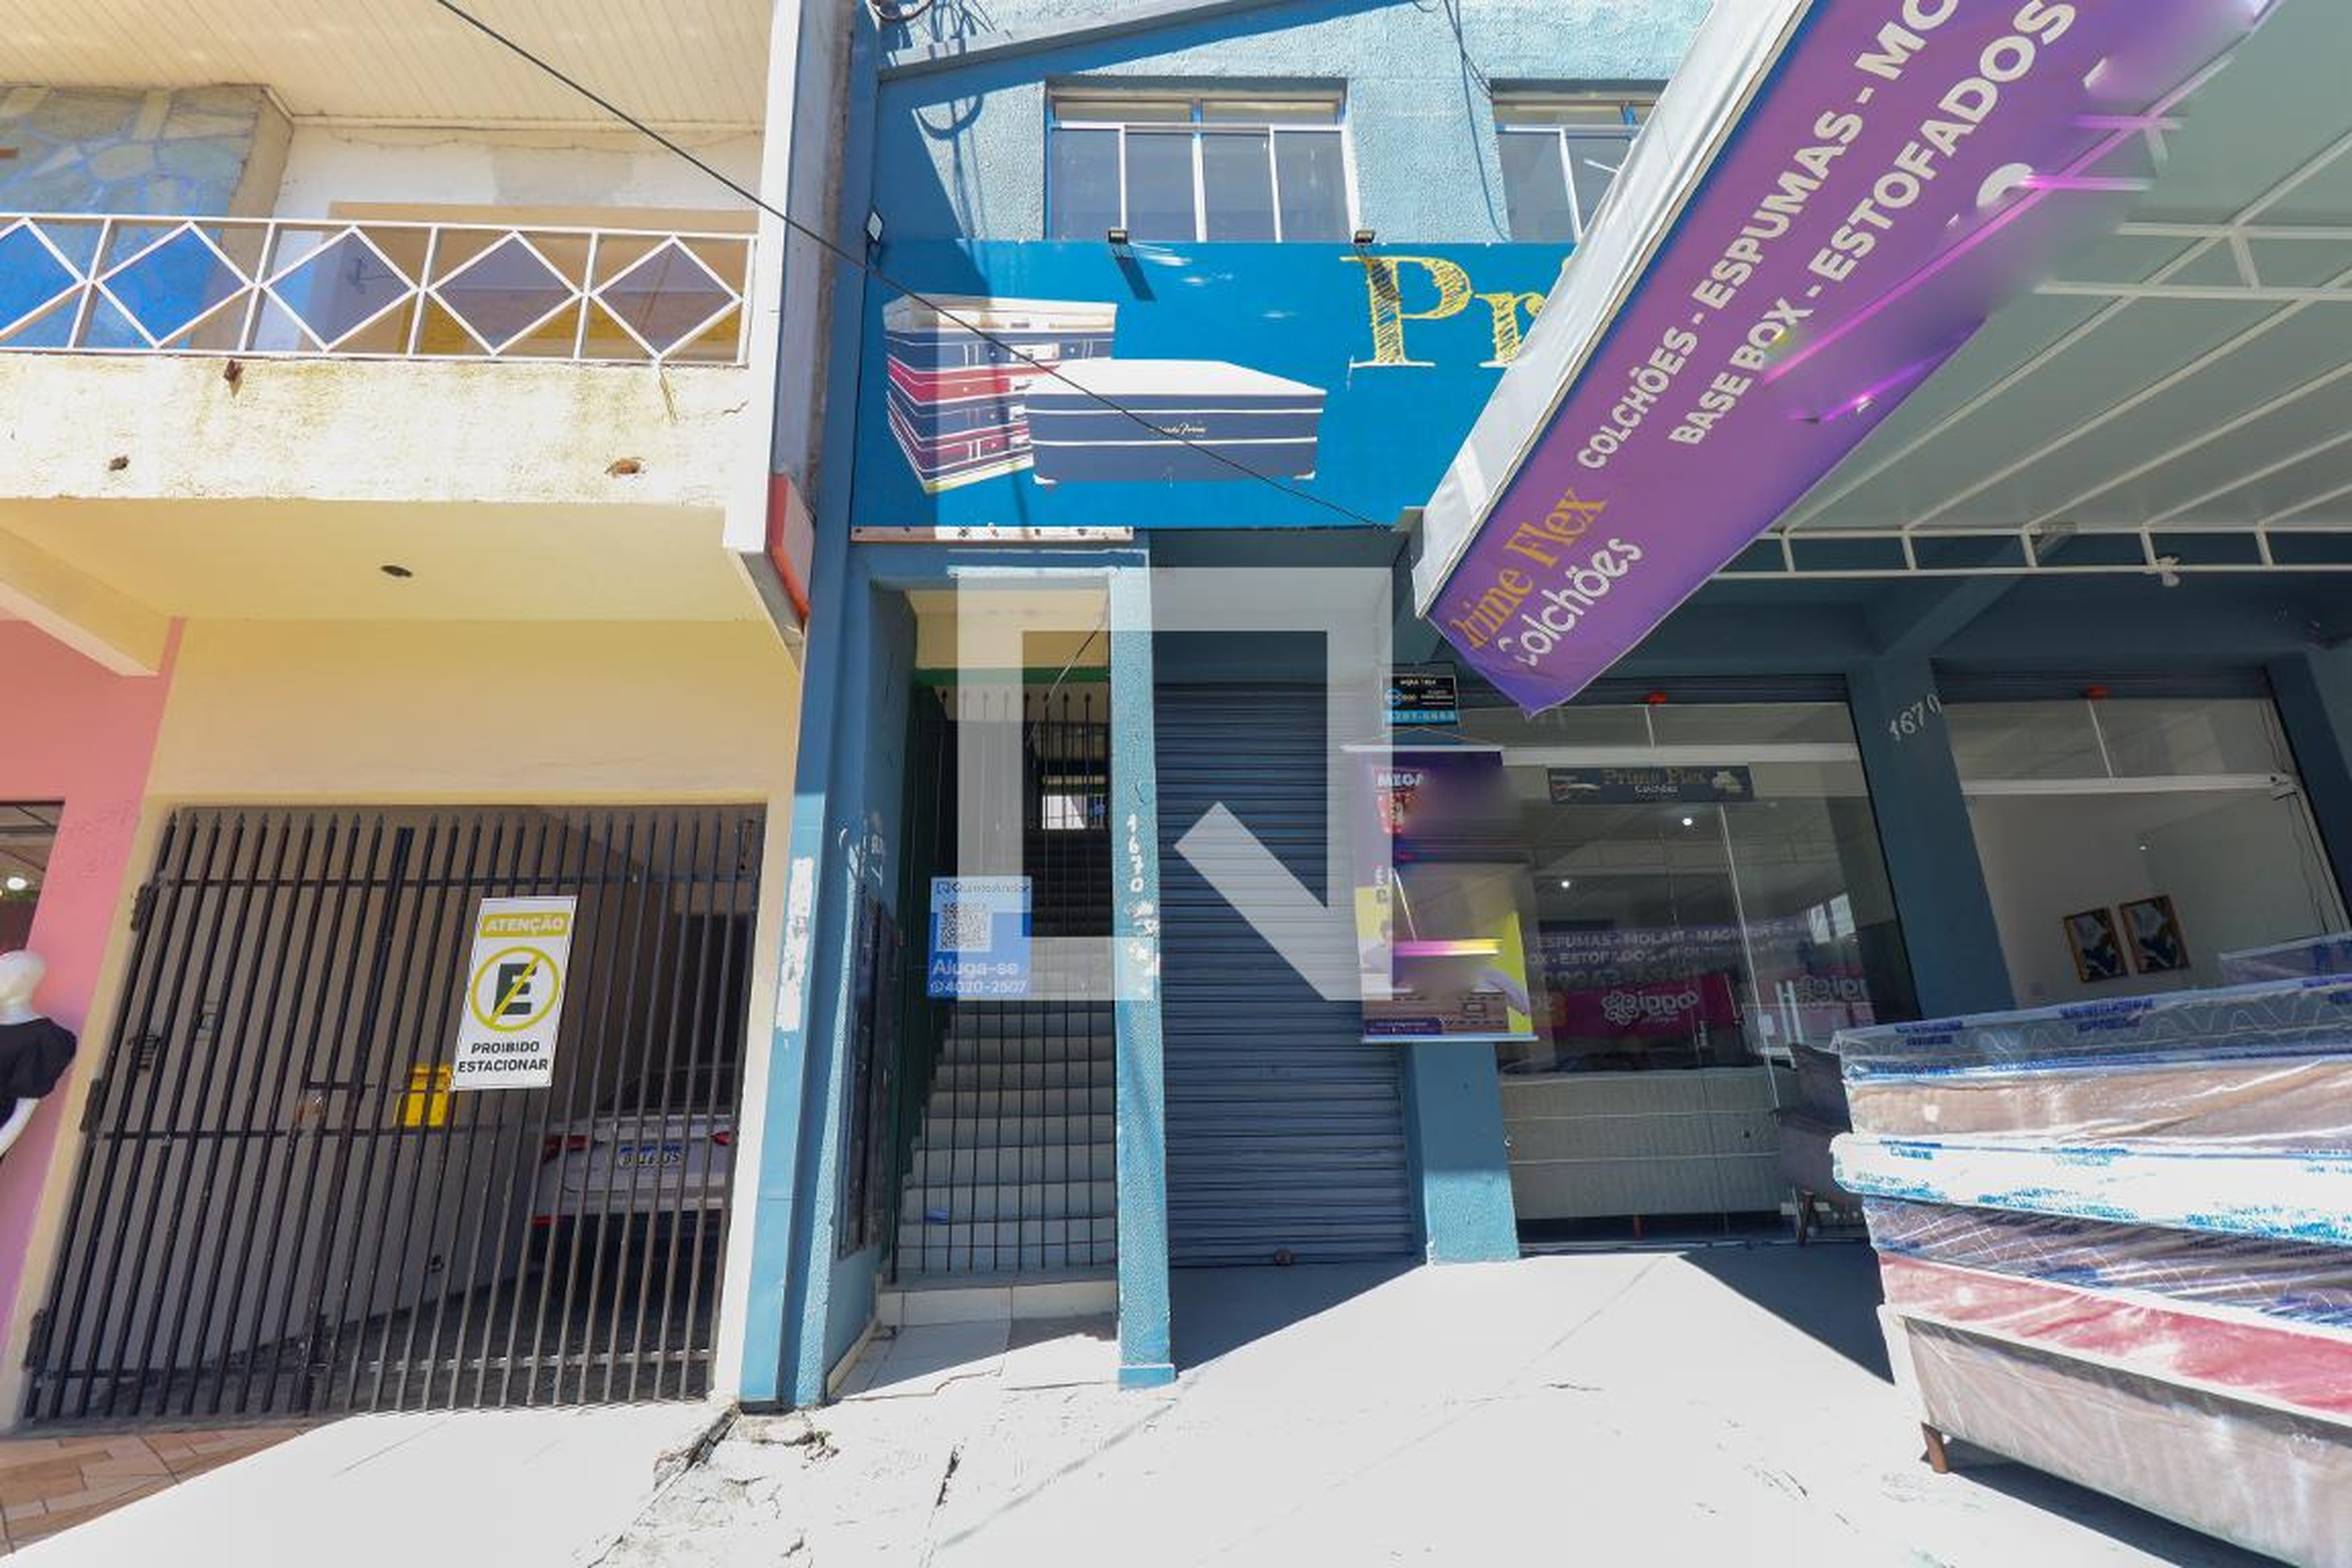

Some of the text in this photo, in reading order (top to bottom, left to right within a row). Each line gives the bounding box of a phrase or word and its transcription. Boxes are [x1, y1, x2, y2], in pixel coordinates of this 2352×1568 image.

[1668, 372, 1753, 445] BASE
[1730, 298, 1814, 370] BOX
[1808, 0, 2075, 281] ESTOFADOS
[1340, 255, 1571, 368] Pr
[1577, 326, 1698, 469] COLCHÕES
[1692, 111, 1863, 308] ESPUMAS
[1449, 488, 1607, 649] rime Flex
[1890, 693, 1942, 742] 1670
[485, 915, 564, 936] ATENÇÃO
[932, 959, 1019, 978] Aluga-se
[459, 1059, 548, 1072] ESTACIONAR
[471, 1042, 540, 1054] PROIBIDO
